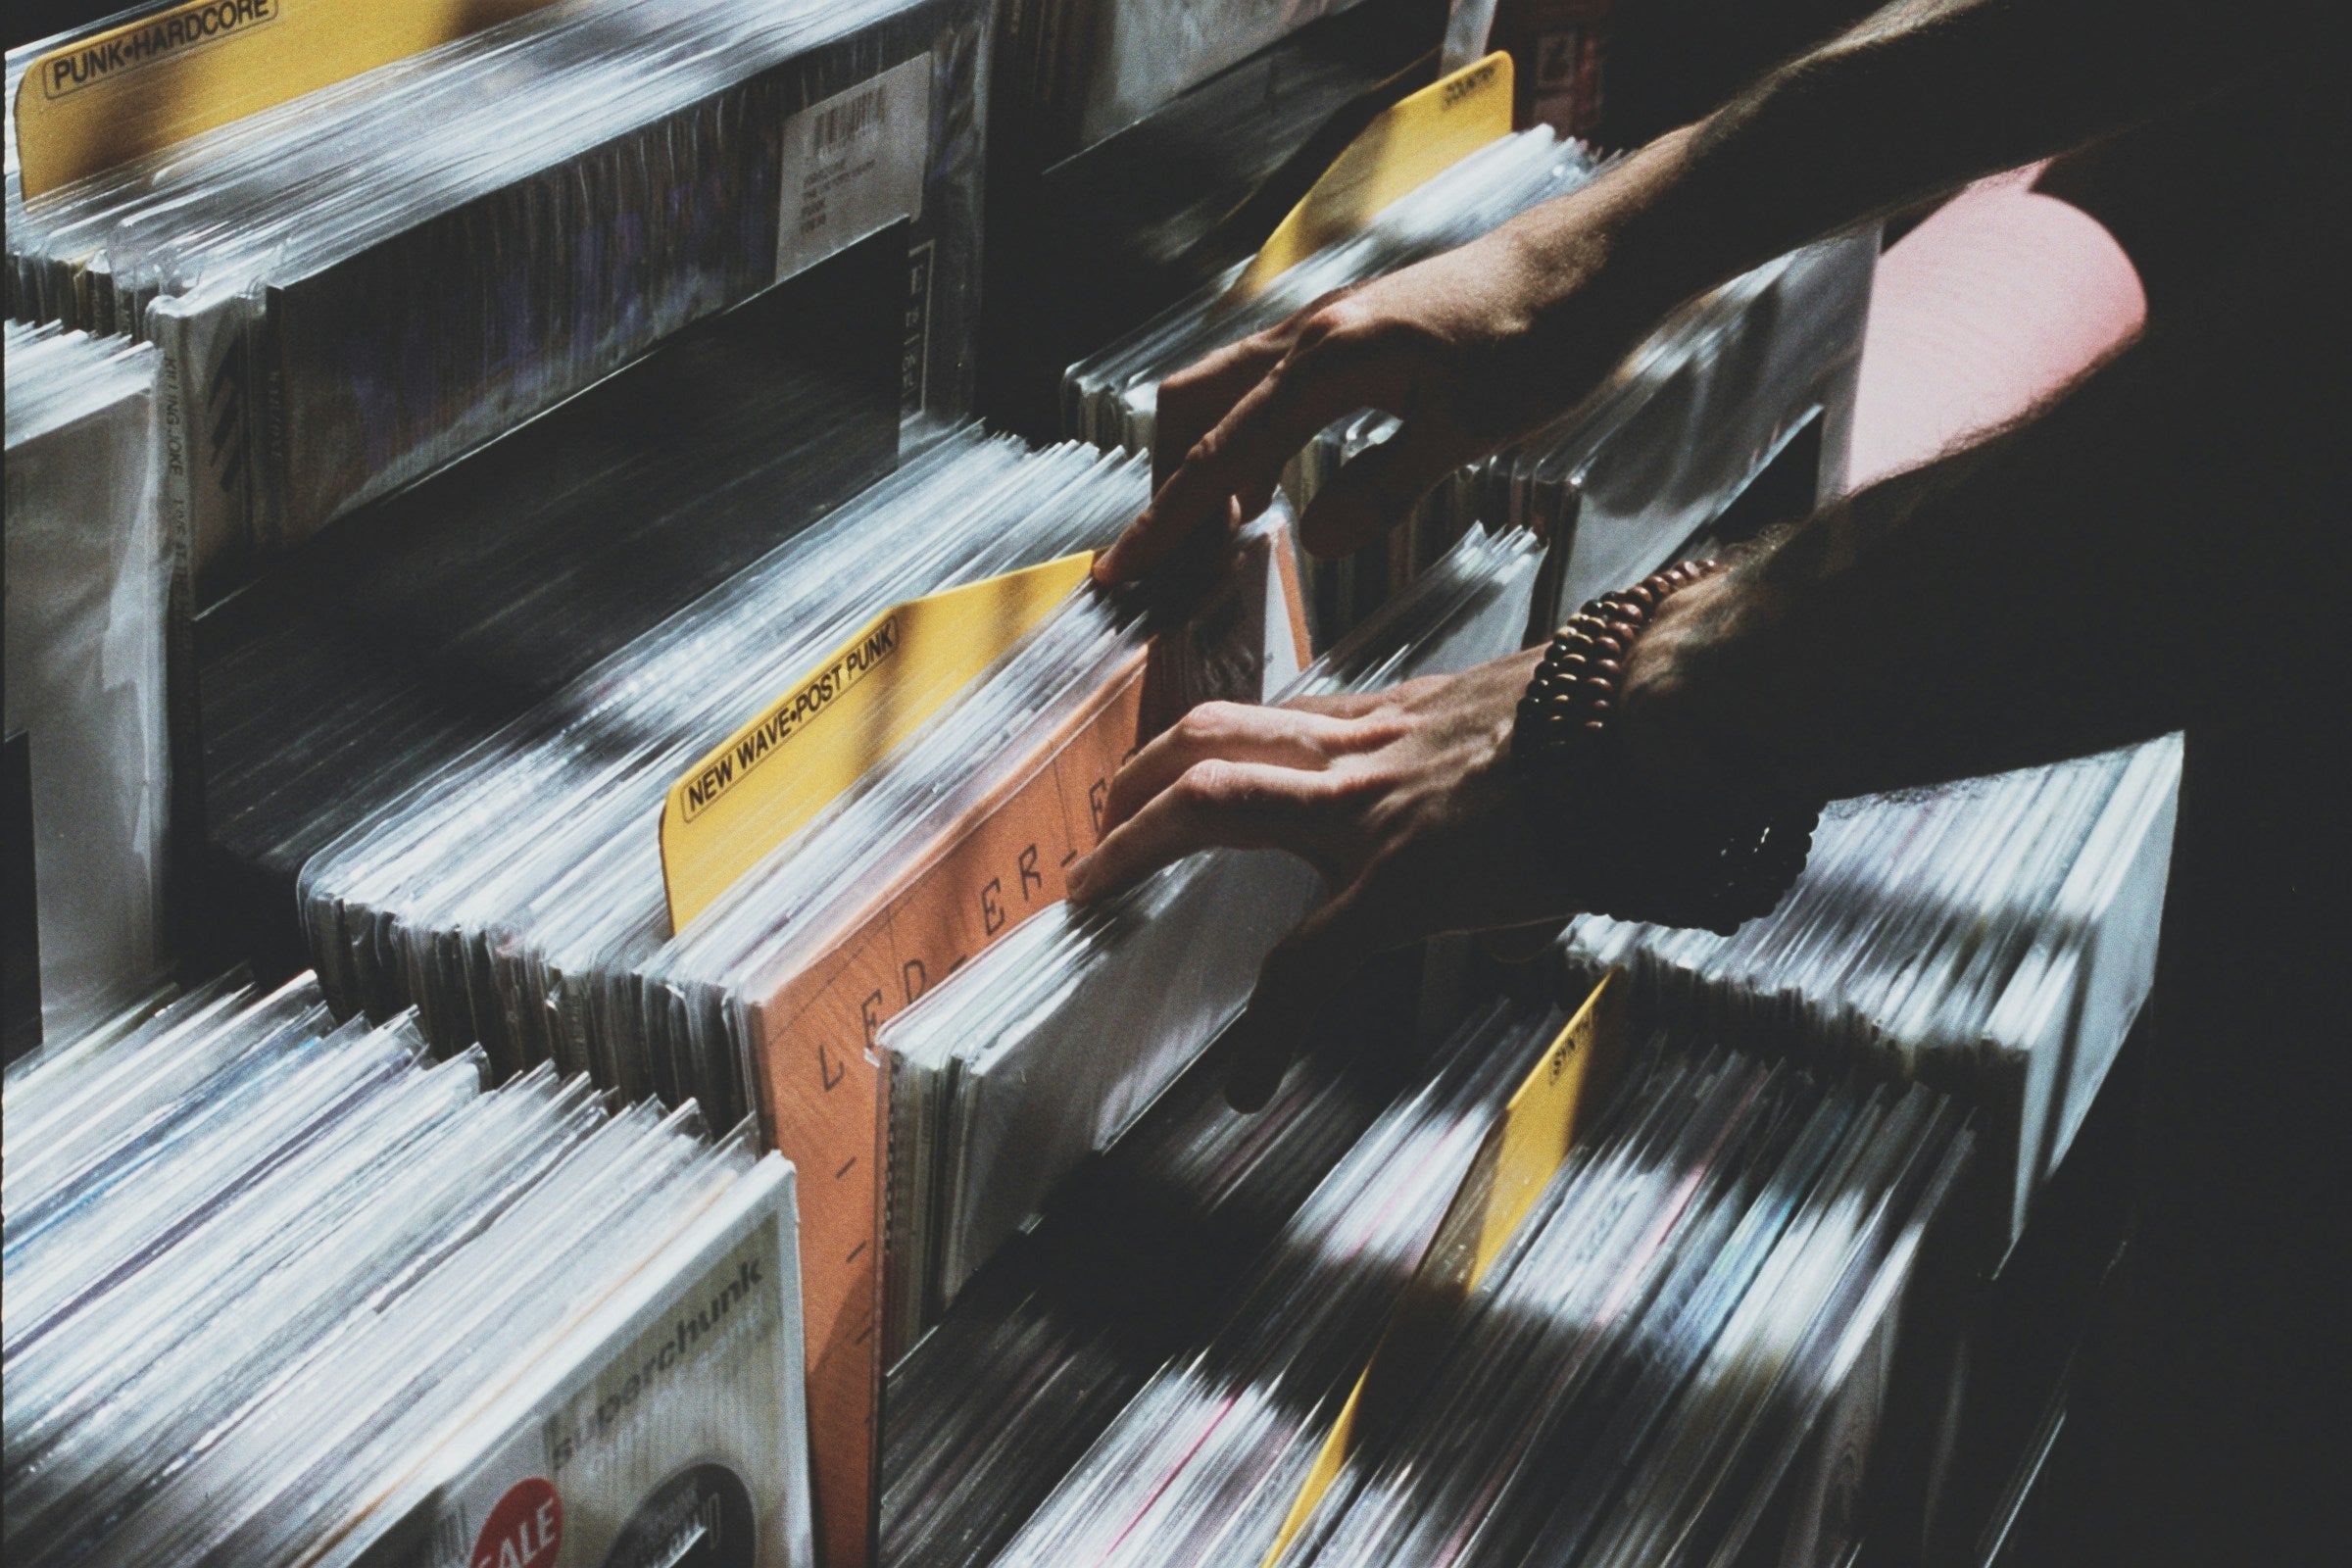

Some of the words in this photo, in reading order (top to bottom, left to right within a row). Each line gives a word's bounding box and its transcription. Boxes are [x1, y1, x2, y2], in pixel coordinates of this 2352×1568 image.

[688, 755, 733, 812] NEW
[846, 623, 895, 680] PUNK
[551, 1258, 763, 1471] superchunk
[477, 1497, 556, 1568] ALE
